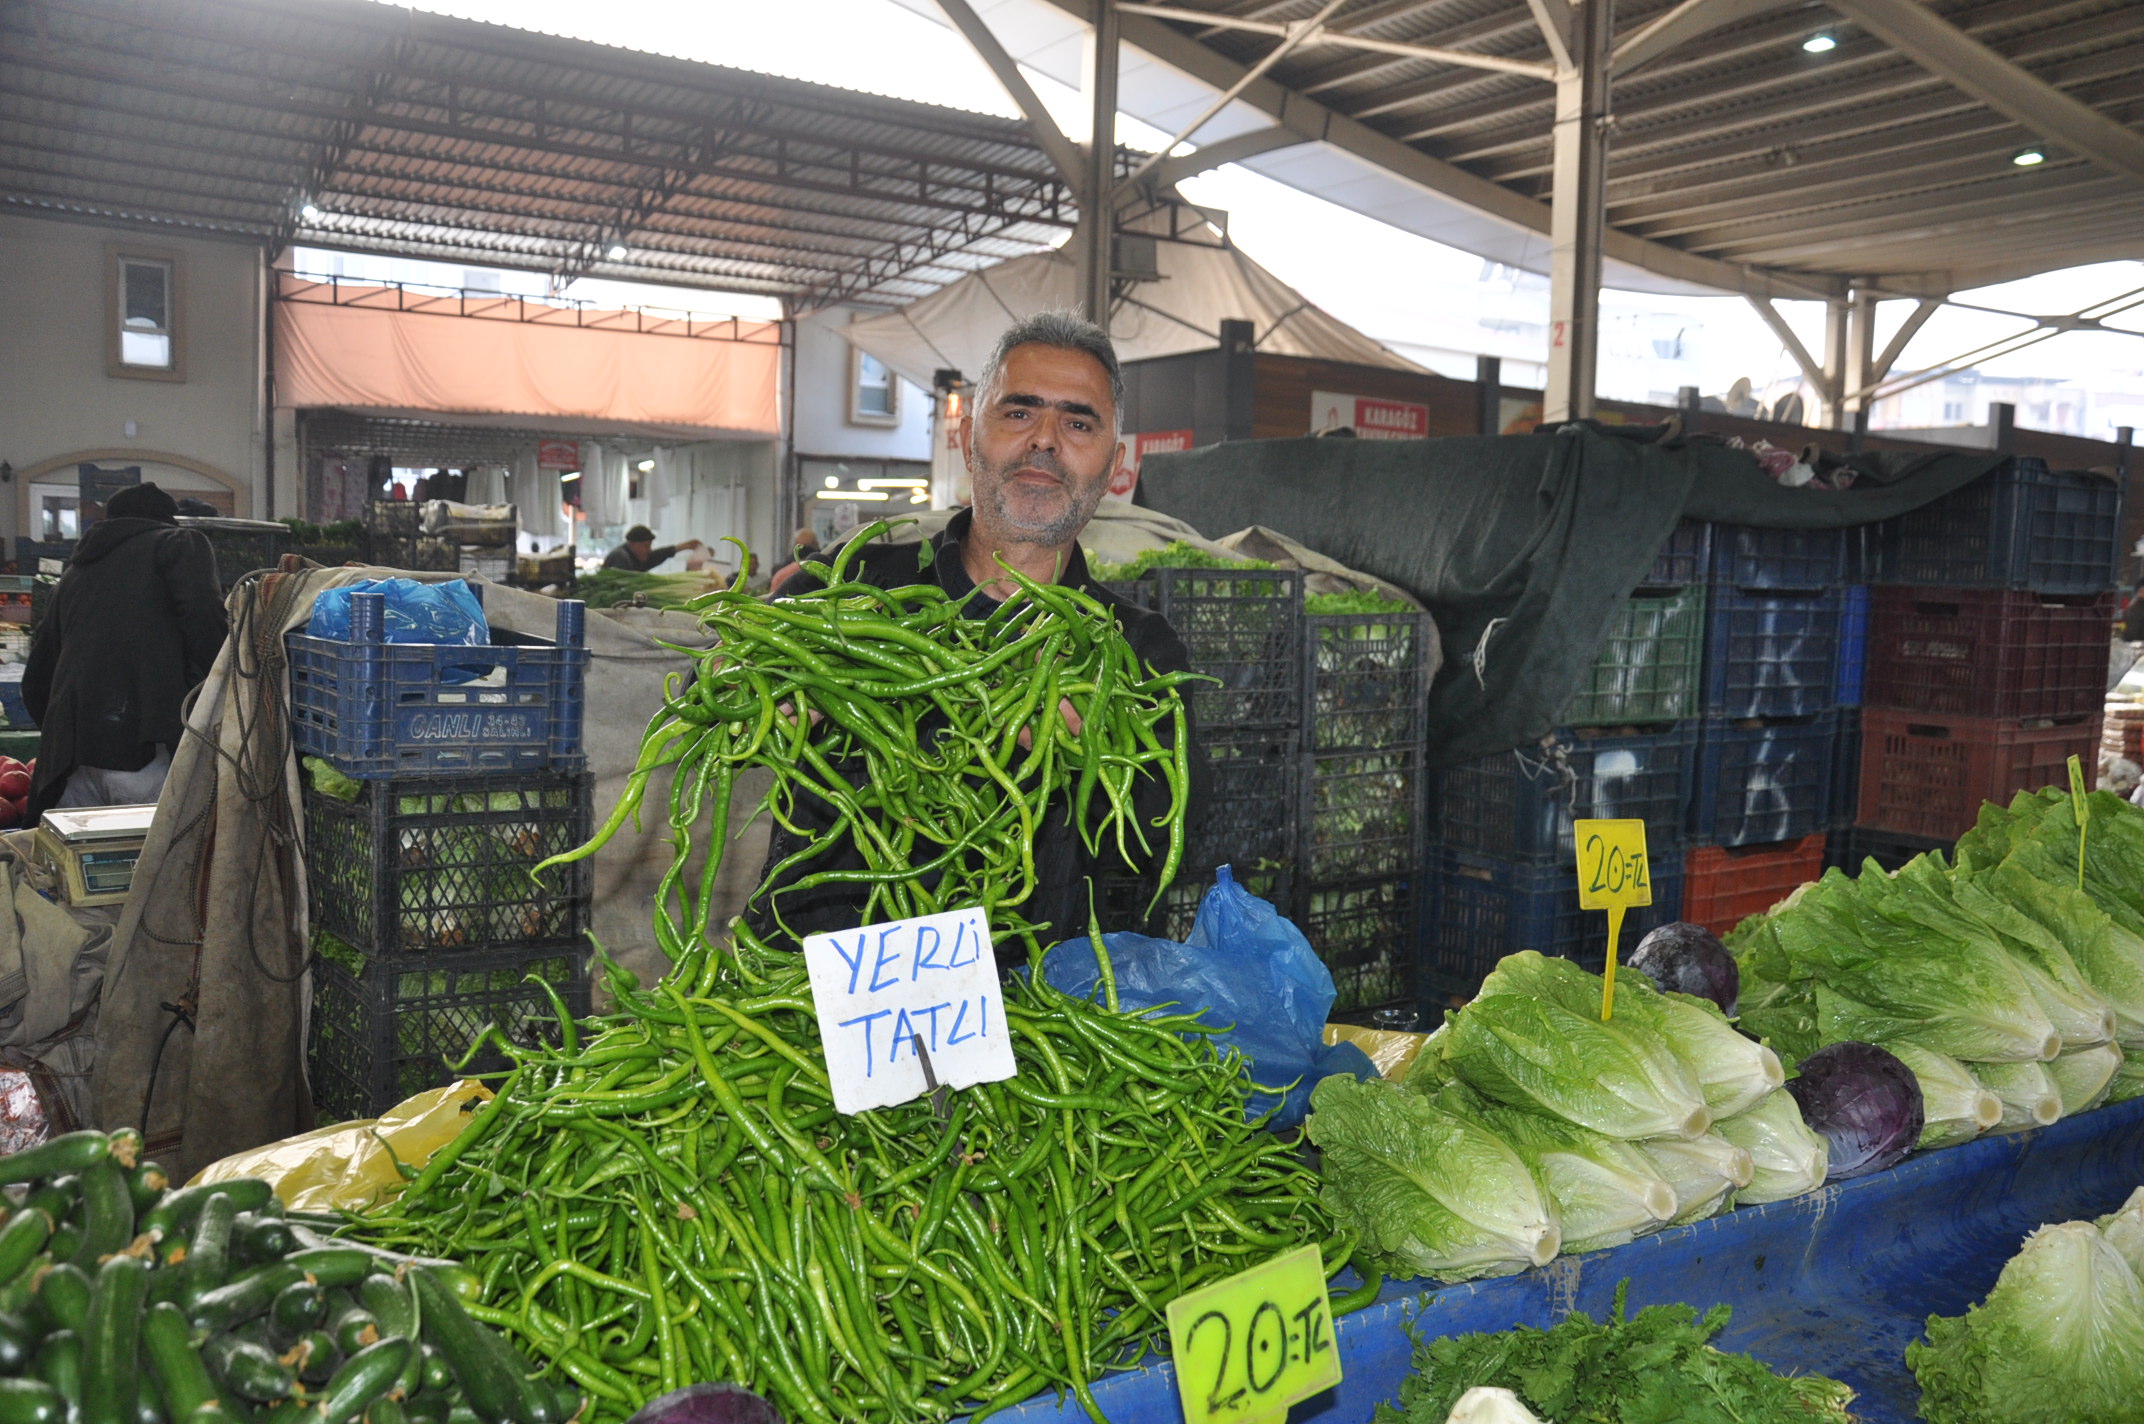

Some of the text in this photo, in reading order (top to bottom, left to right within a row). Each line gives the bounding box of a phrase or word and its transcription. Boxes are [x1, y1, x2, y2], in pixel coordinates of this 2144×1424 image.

[1553, 320, 1565, 348] 2
[410, 714, 482, 739] CANLI
[838, 995, 987, 1077] TATLI
